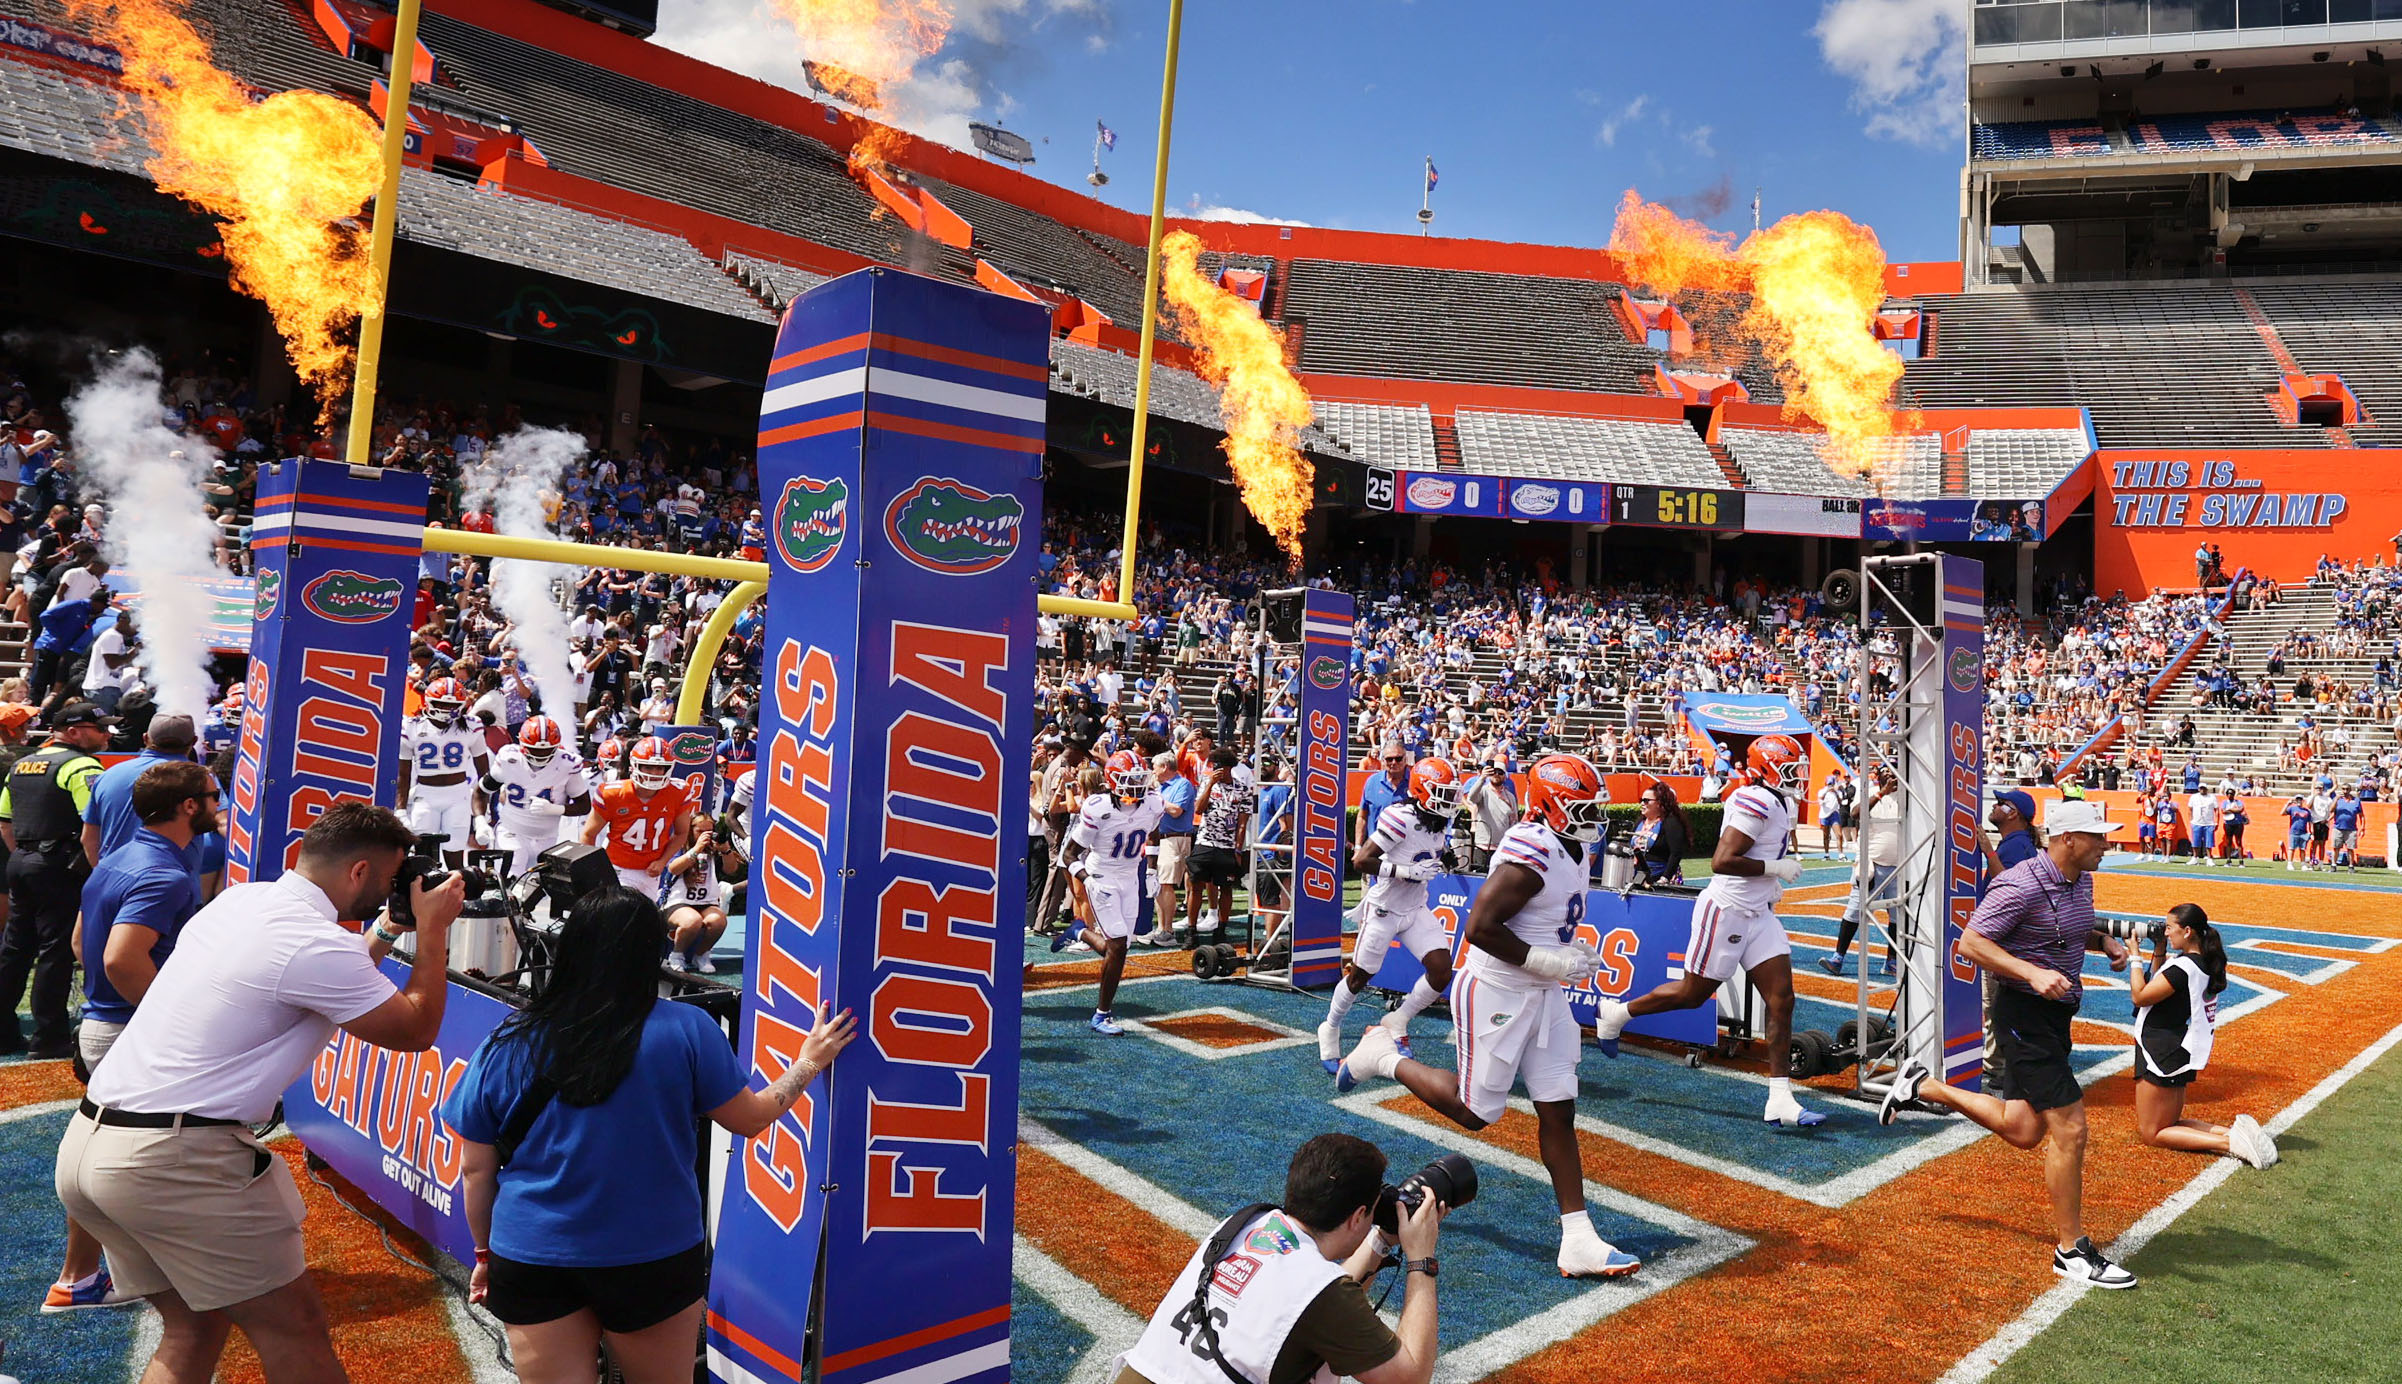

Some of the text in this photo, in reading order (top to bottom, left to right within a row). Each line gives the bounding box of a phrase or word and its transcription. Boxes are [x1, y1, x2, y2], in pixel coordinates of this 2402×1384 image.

[2112, 461, 2262, 488] THIS IS...
[1367, 477, 1392, 502] 25
[1464, 481, 1480, 508] 0
[1568, 487, 1584, 514] 0
[1616, 486, 1634, 499] QTR
[1621, 501, 1629, 520] 1
[1658, 490, 1717, 524] 5:16
[1822, 500, 1844, 513] BALL
[2112, 493, 2346, 527] THE SWAMP
[14, 761, 49, 775] POLICE
[418, 742, 464, 769] 28
[1303, 709, 1341, 902] GATORS
[622, 818, 665, 851] 41
[1111, 829, 1147, 859] 10
[1950, 721, 1978, 984] GATORS
[686, 888, 707, 900] 69
[1439, 893, 1468, 906] ONLY
[744, 637, 838, 1235] GATORS
[863, 620, 1009, 1245] FLORIDA
[382, 1155, 452, 1216] GET OUT ALIVE
[1217, 1261, 1249, 1283] BUREAU
